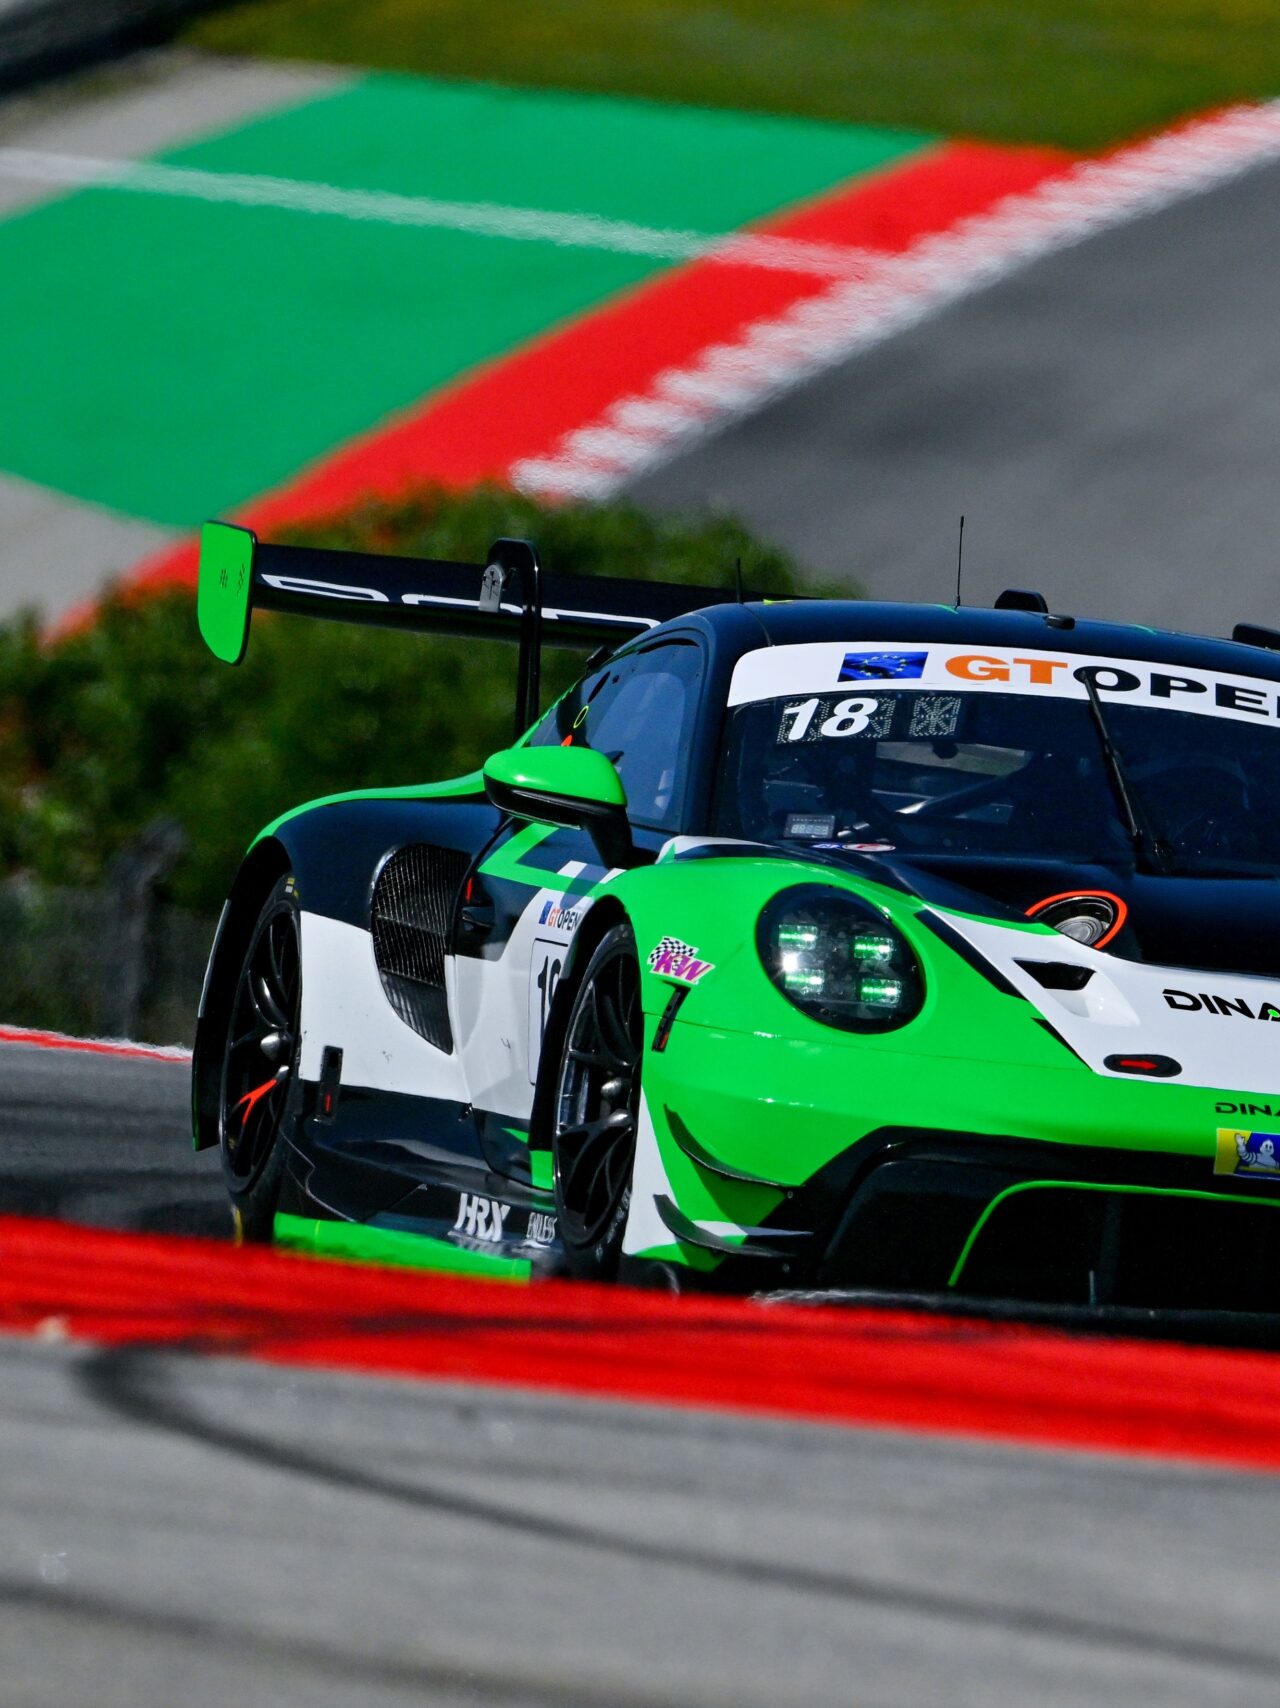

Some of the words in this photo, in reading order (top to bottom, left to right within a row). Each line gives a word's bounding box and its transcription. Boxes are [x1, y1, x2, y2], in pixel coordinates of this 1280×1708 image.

[784, 697, 879, 741] 18
[653, 949, 711, 981] KW
[453, 1192, 511, 1242] HRX
